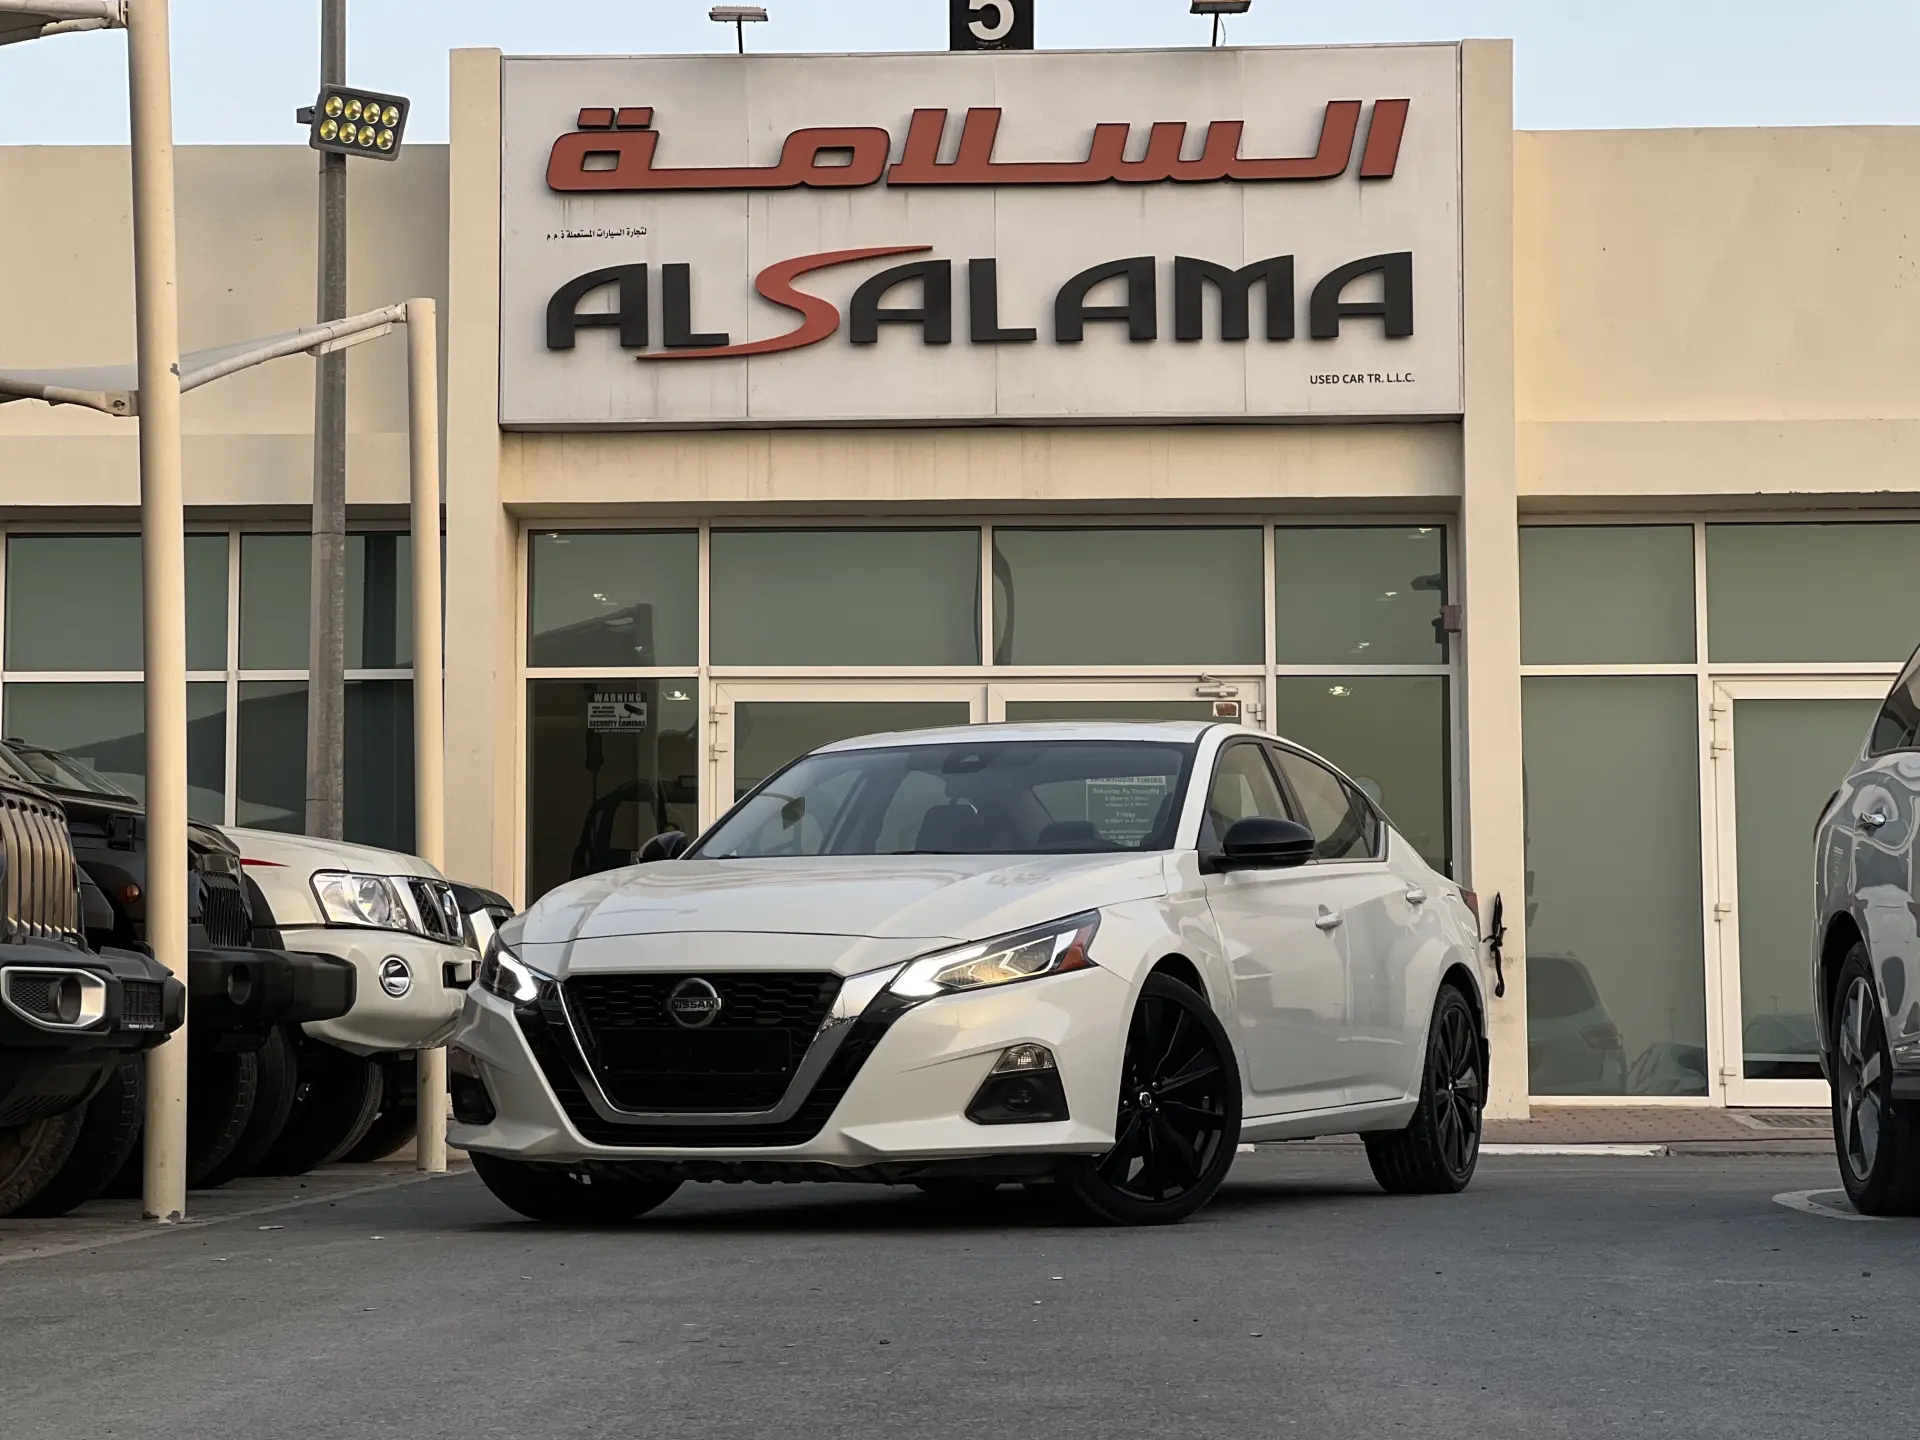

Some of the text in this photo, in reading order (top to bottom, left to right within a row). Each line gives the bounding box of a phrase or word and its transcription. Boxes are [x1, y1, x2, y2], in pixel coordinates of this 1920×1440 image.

[968, 0, 1014, 40] 5
[546, 99, 1410, 193] السلامة
[566, 229, 595, 238] المستعملة
[597, 228, 625, 239] السيارات
[626, 226, 647, 238] لتجارة
[1310, 373, 1415, 385] USED CAR TR. L.L.C.
[594, 693, 642, 702] WARNING
[589, 720, 646, 728] SECURITY CAMERAS
[672, 1000, 714, 1008] NISSAN
